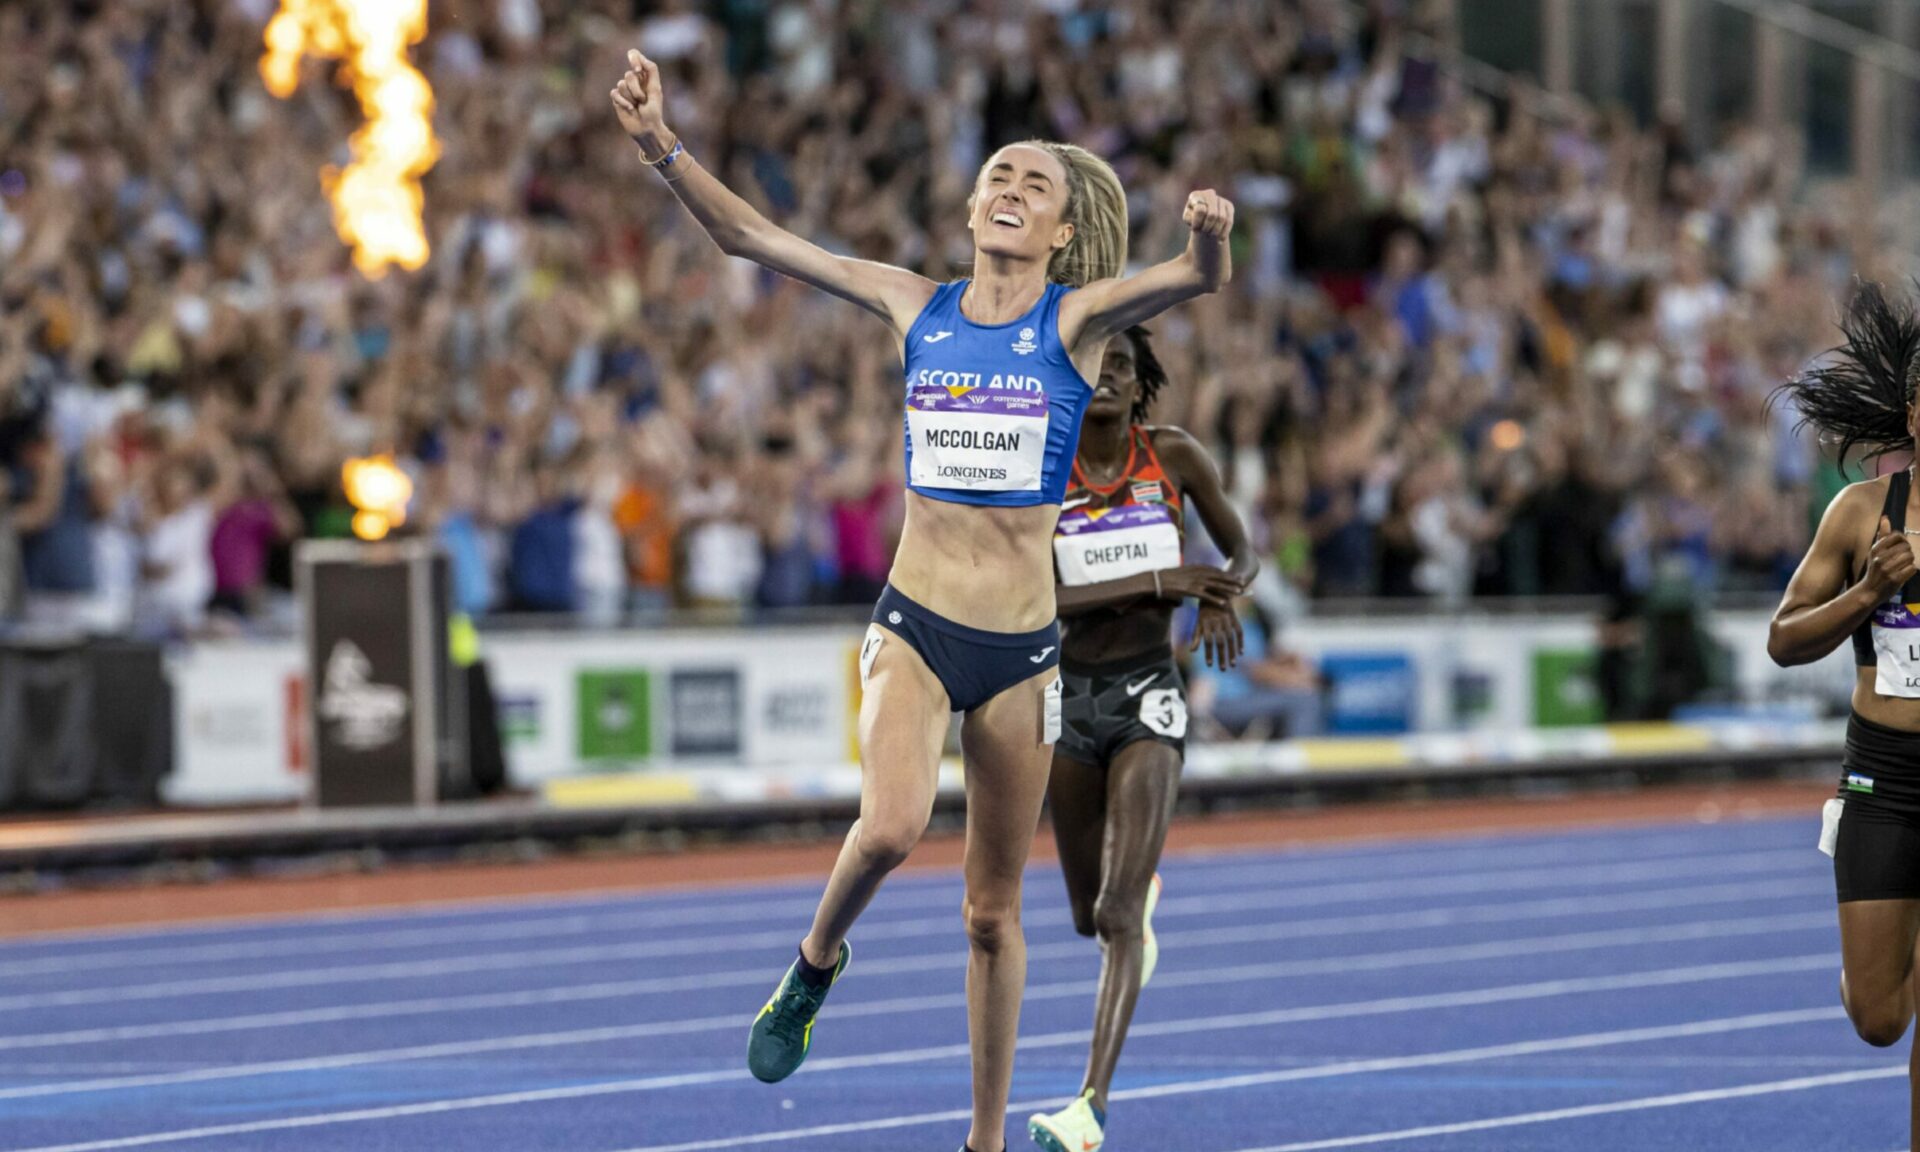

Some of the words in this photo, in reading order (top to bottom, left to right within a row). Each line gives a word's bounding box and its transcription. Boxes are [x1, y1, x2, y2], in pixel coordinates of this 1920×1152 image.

[918, 369, 1043, 394] SCOTLAND
[926, 428, 1020, 452] MCCOLGAN
[937, 465, 1007, 480] LONGINES
[1084, 542, 1149, 565] CHEPTAI
